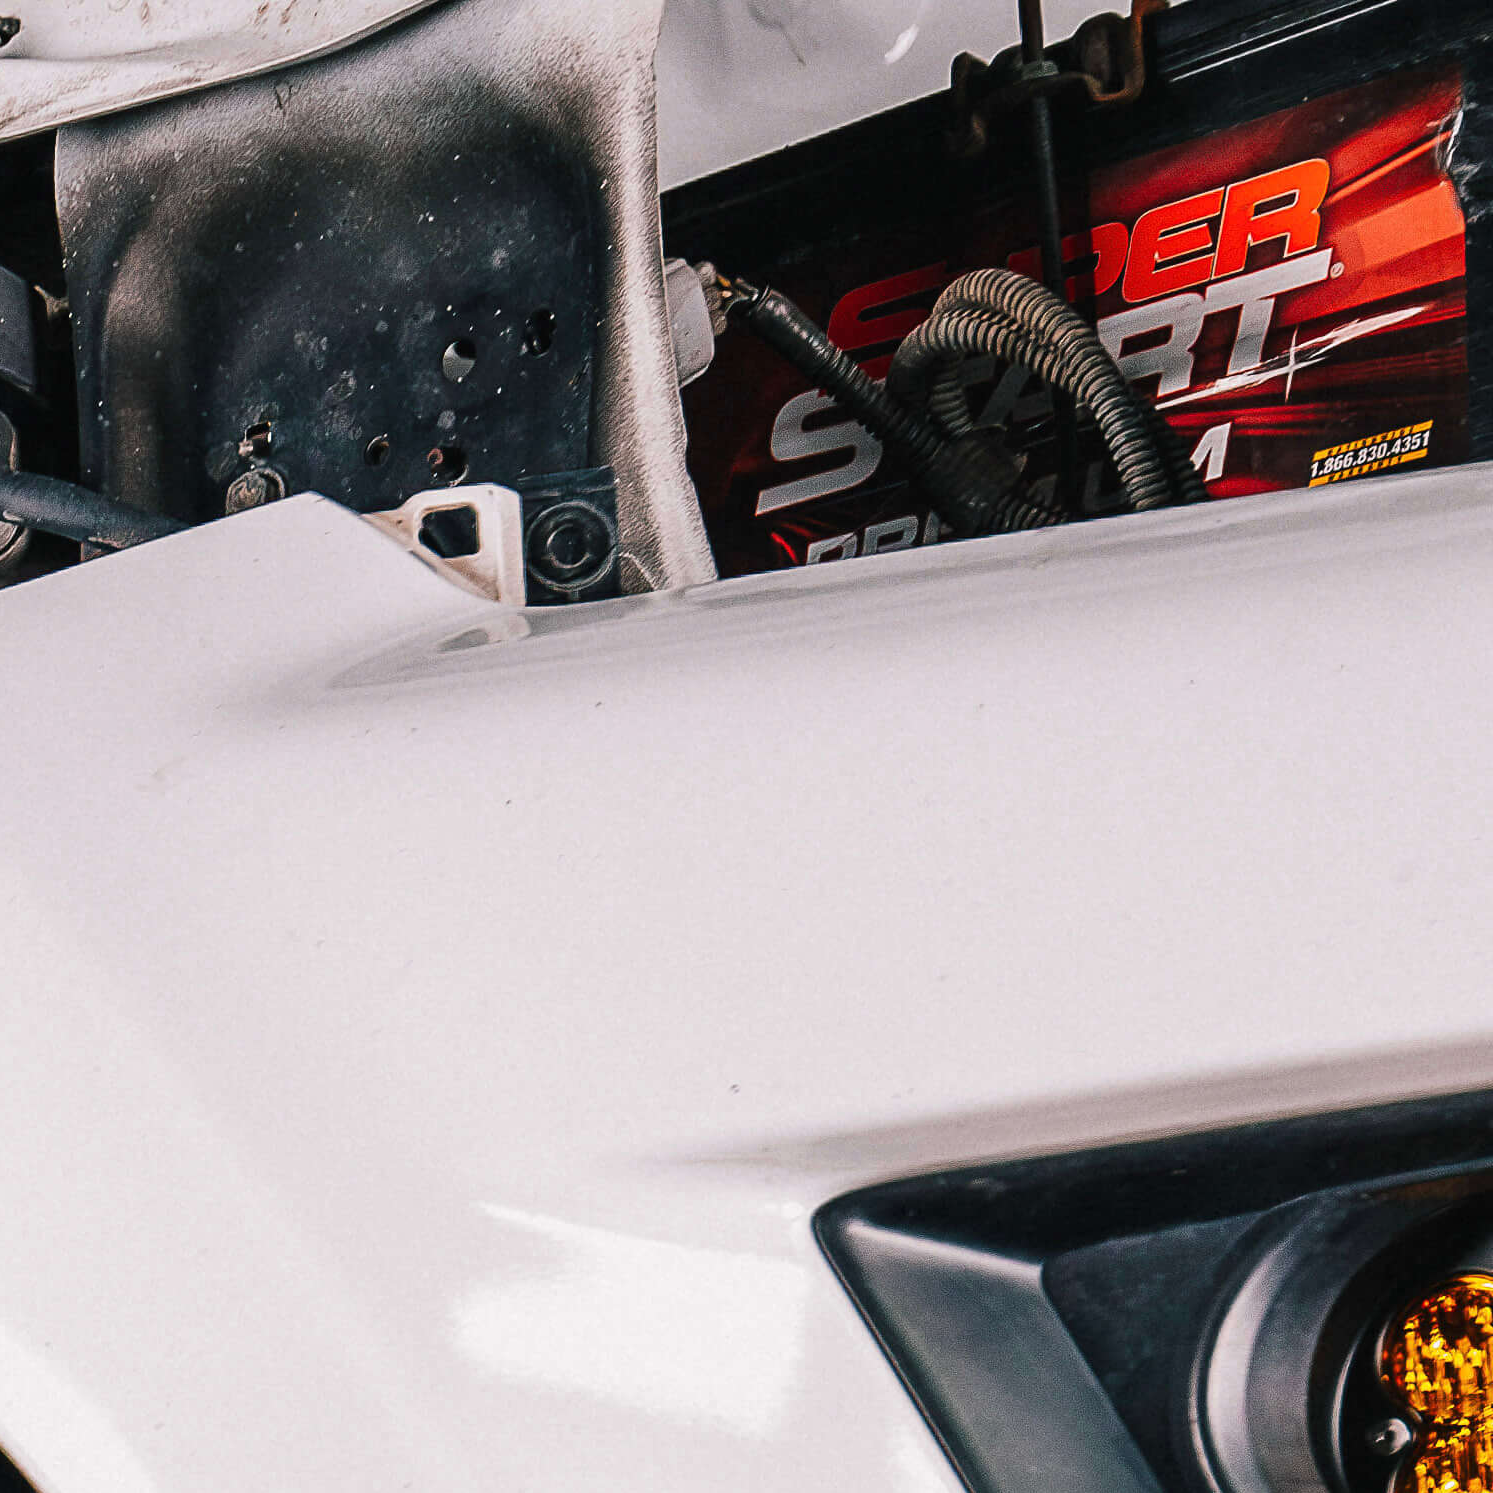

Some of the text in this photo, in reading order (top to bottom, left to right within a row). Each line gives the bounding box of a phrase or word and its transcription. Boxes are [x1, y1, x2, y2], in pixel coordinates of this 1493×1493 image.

[826, 157, 1332, 380] SPER
[754, 247, 1333, 516] SRT
[1310, 429, 1430, 478] 1.866.830.4351
